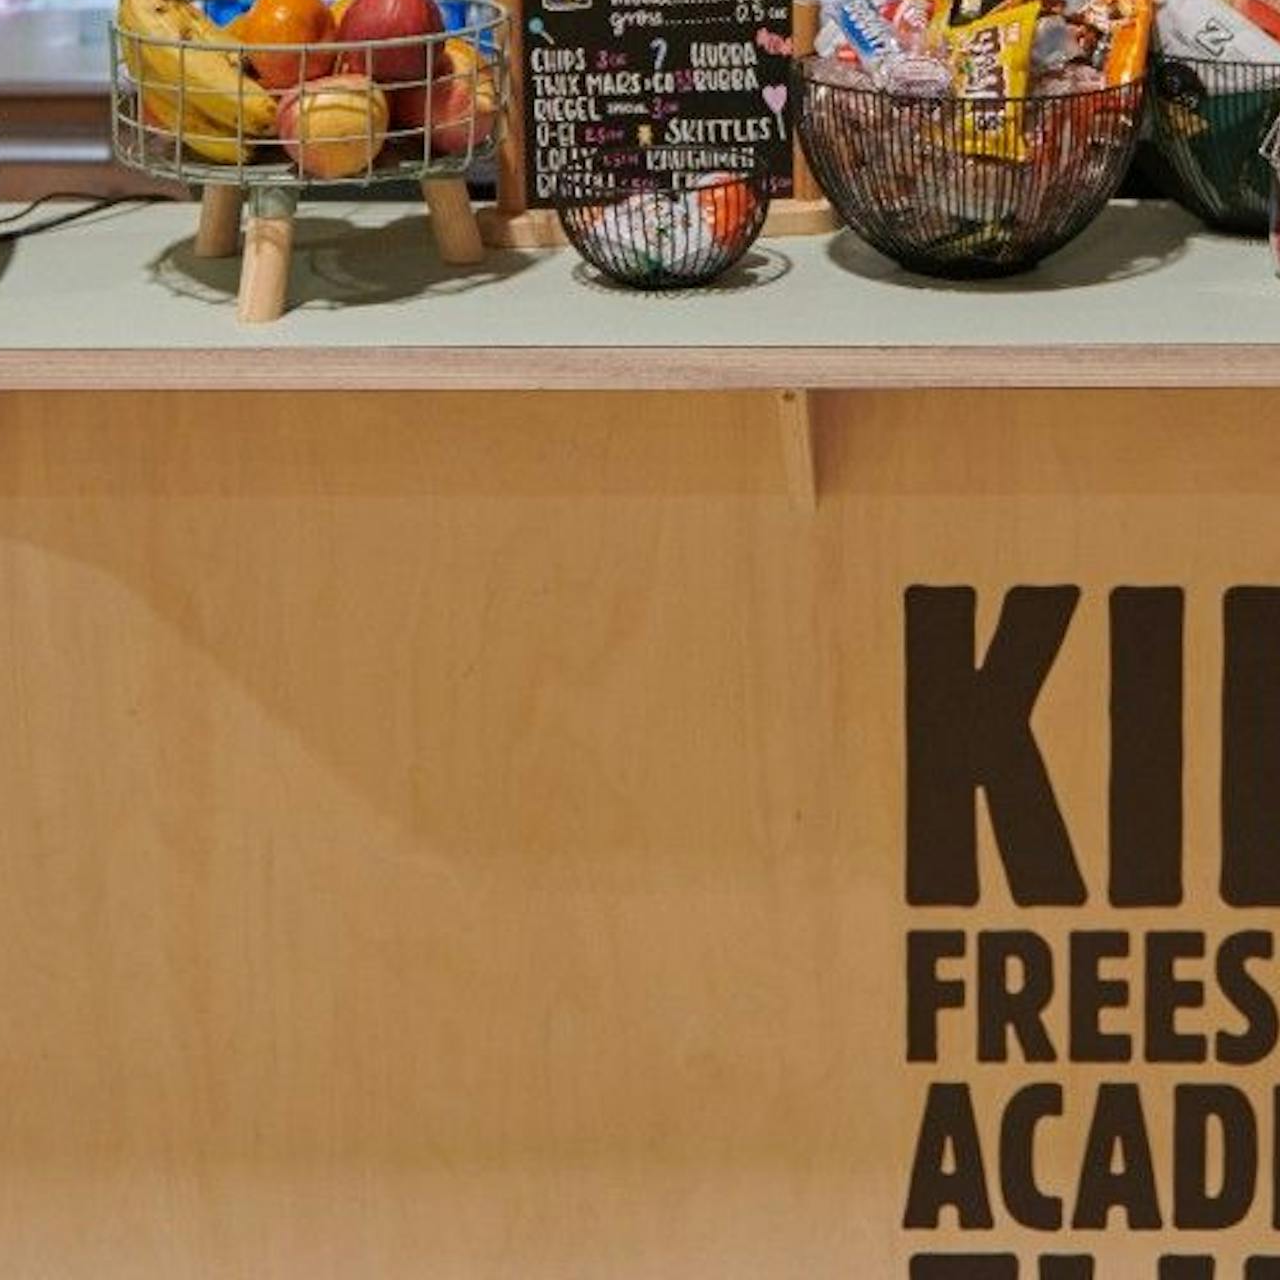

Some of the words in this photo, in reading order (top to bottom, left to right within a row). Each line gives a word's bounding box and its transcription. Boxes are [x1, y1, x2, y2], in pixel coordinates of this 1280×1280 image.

[531, 47, 586, 73] CHIPS
[532, 75, 580, 97] TWIX
[585, 72, 642, 96] MARS
[534, 97, 602, 121] RIEGEL
[665, 117, 771, 144] SKITTLES
